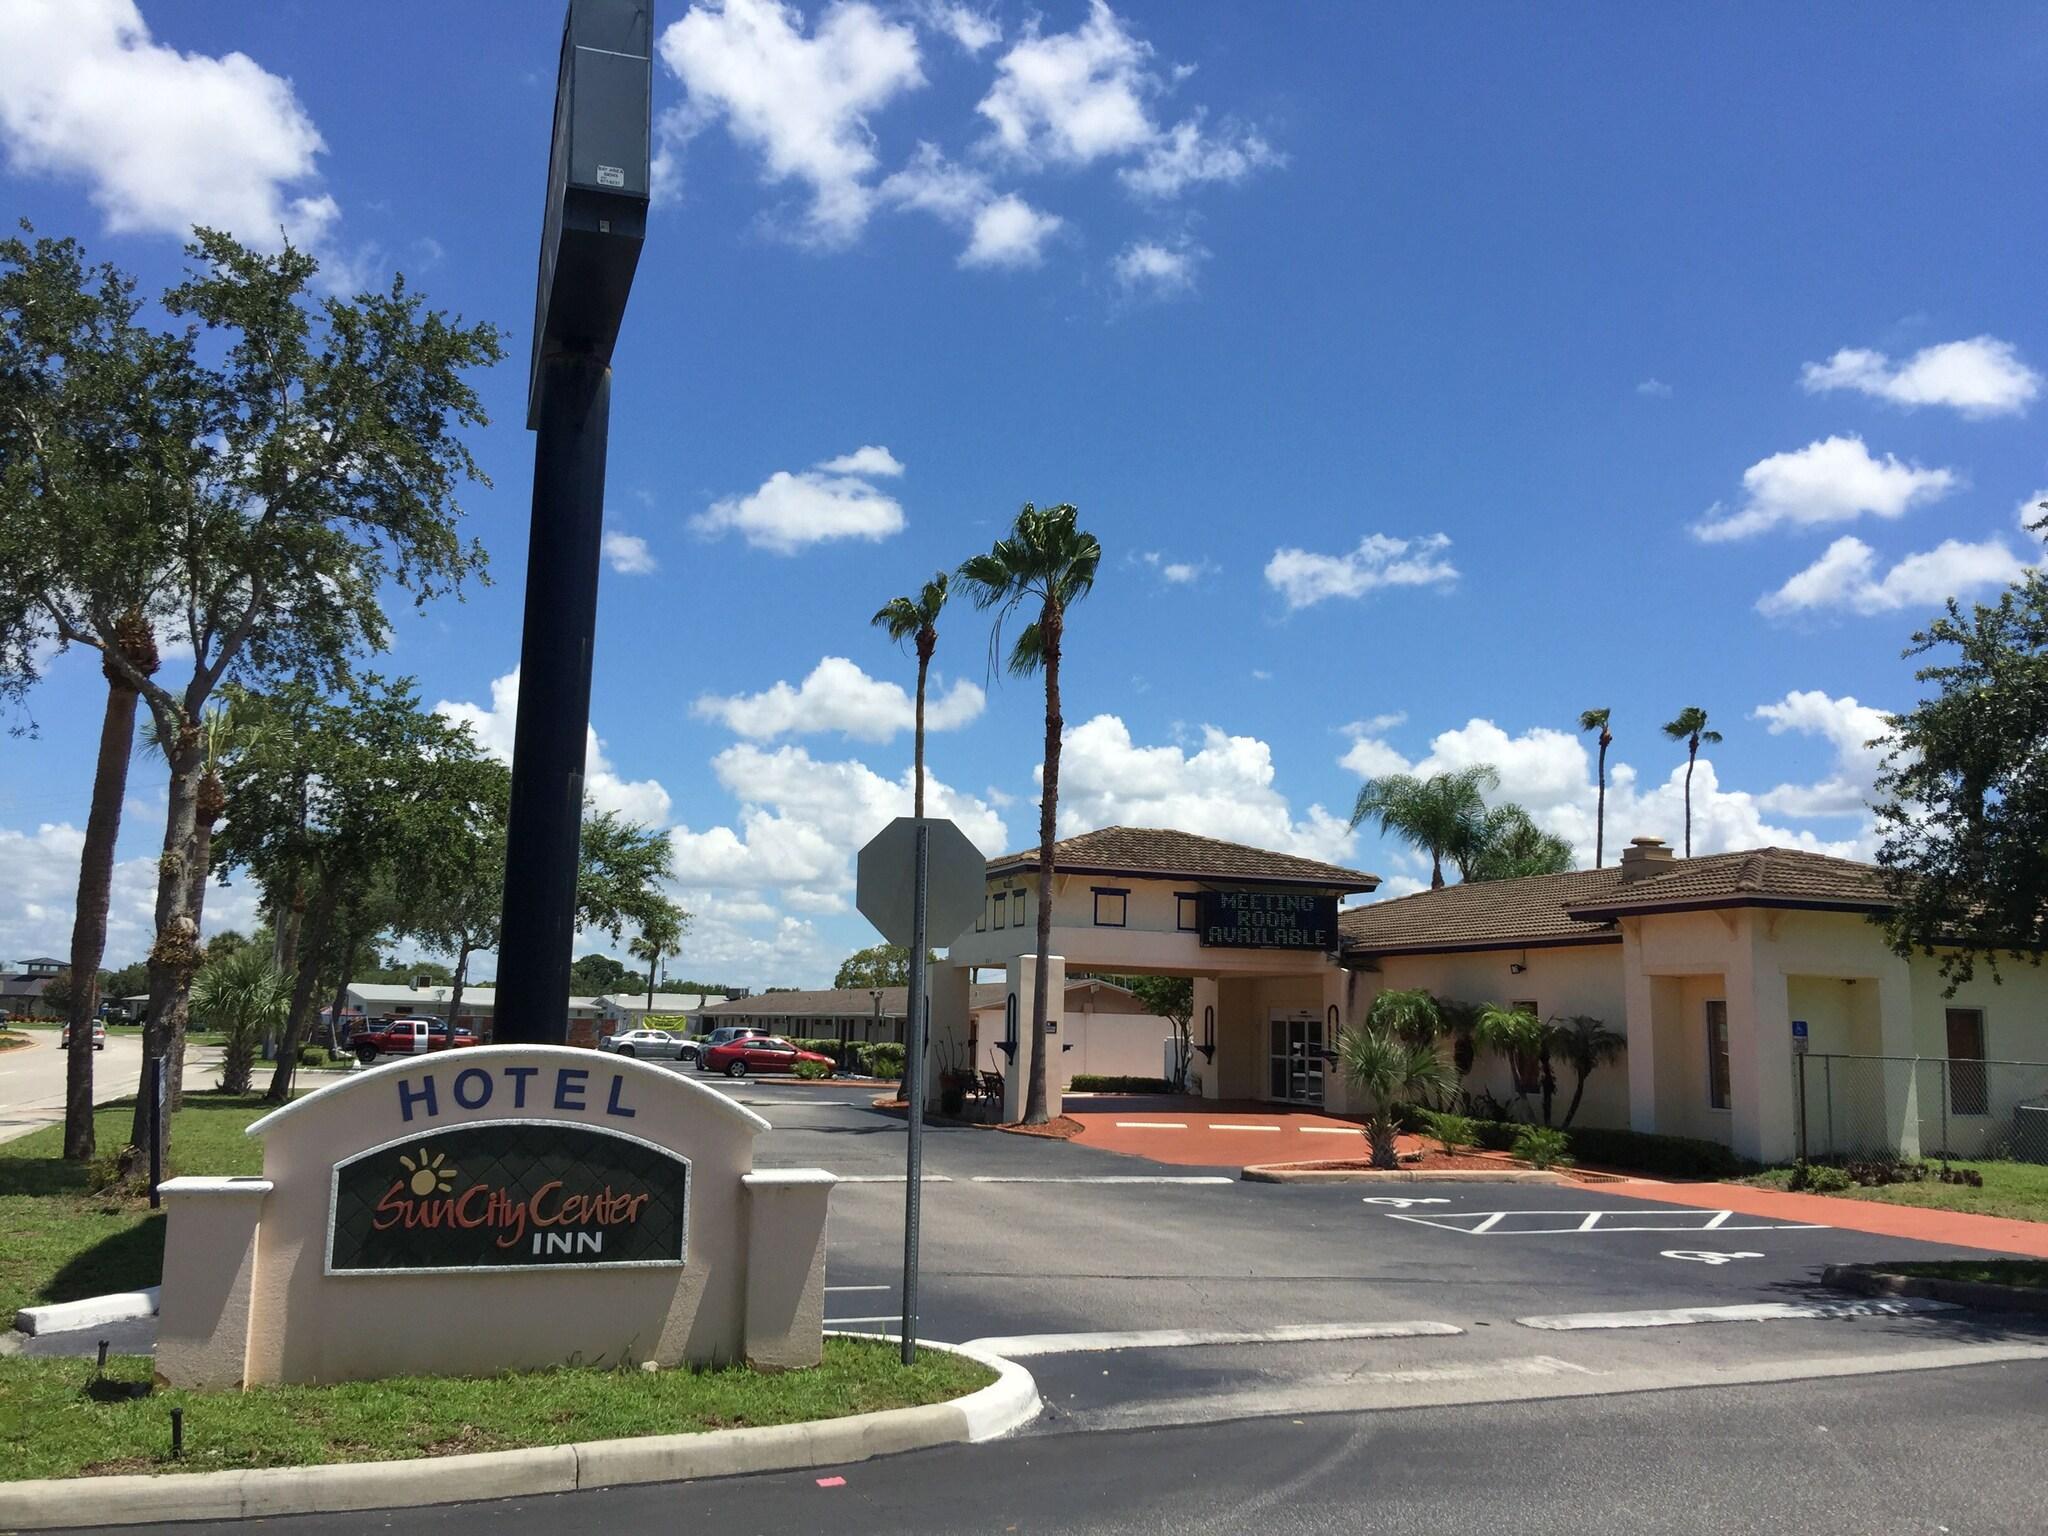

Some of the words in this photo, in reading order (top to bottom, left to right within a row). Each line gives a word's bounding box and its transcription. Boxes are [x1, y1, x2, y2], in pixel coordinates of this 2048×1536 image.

[1220, 893, 1315, 912] MEETING
[1237, 910, 1297, 928] ROOM
[1208, 926, 1328, 946] AVAILABLE
[398, 1067, 636, 1121] HOTEL
[529, 1181, 649, 1227] Center
[532, 1231, 602, 1255] INN
